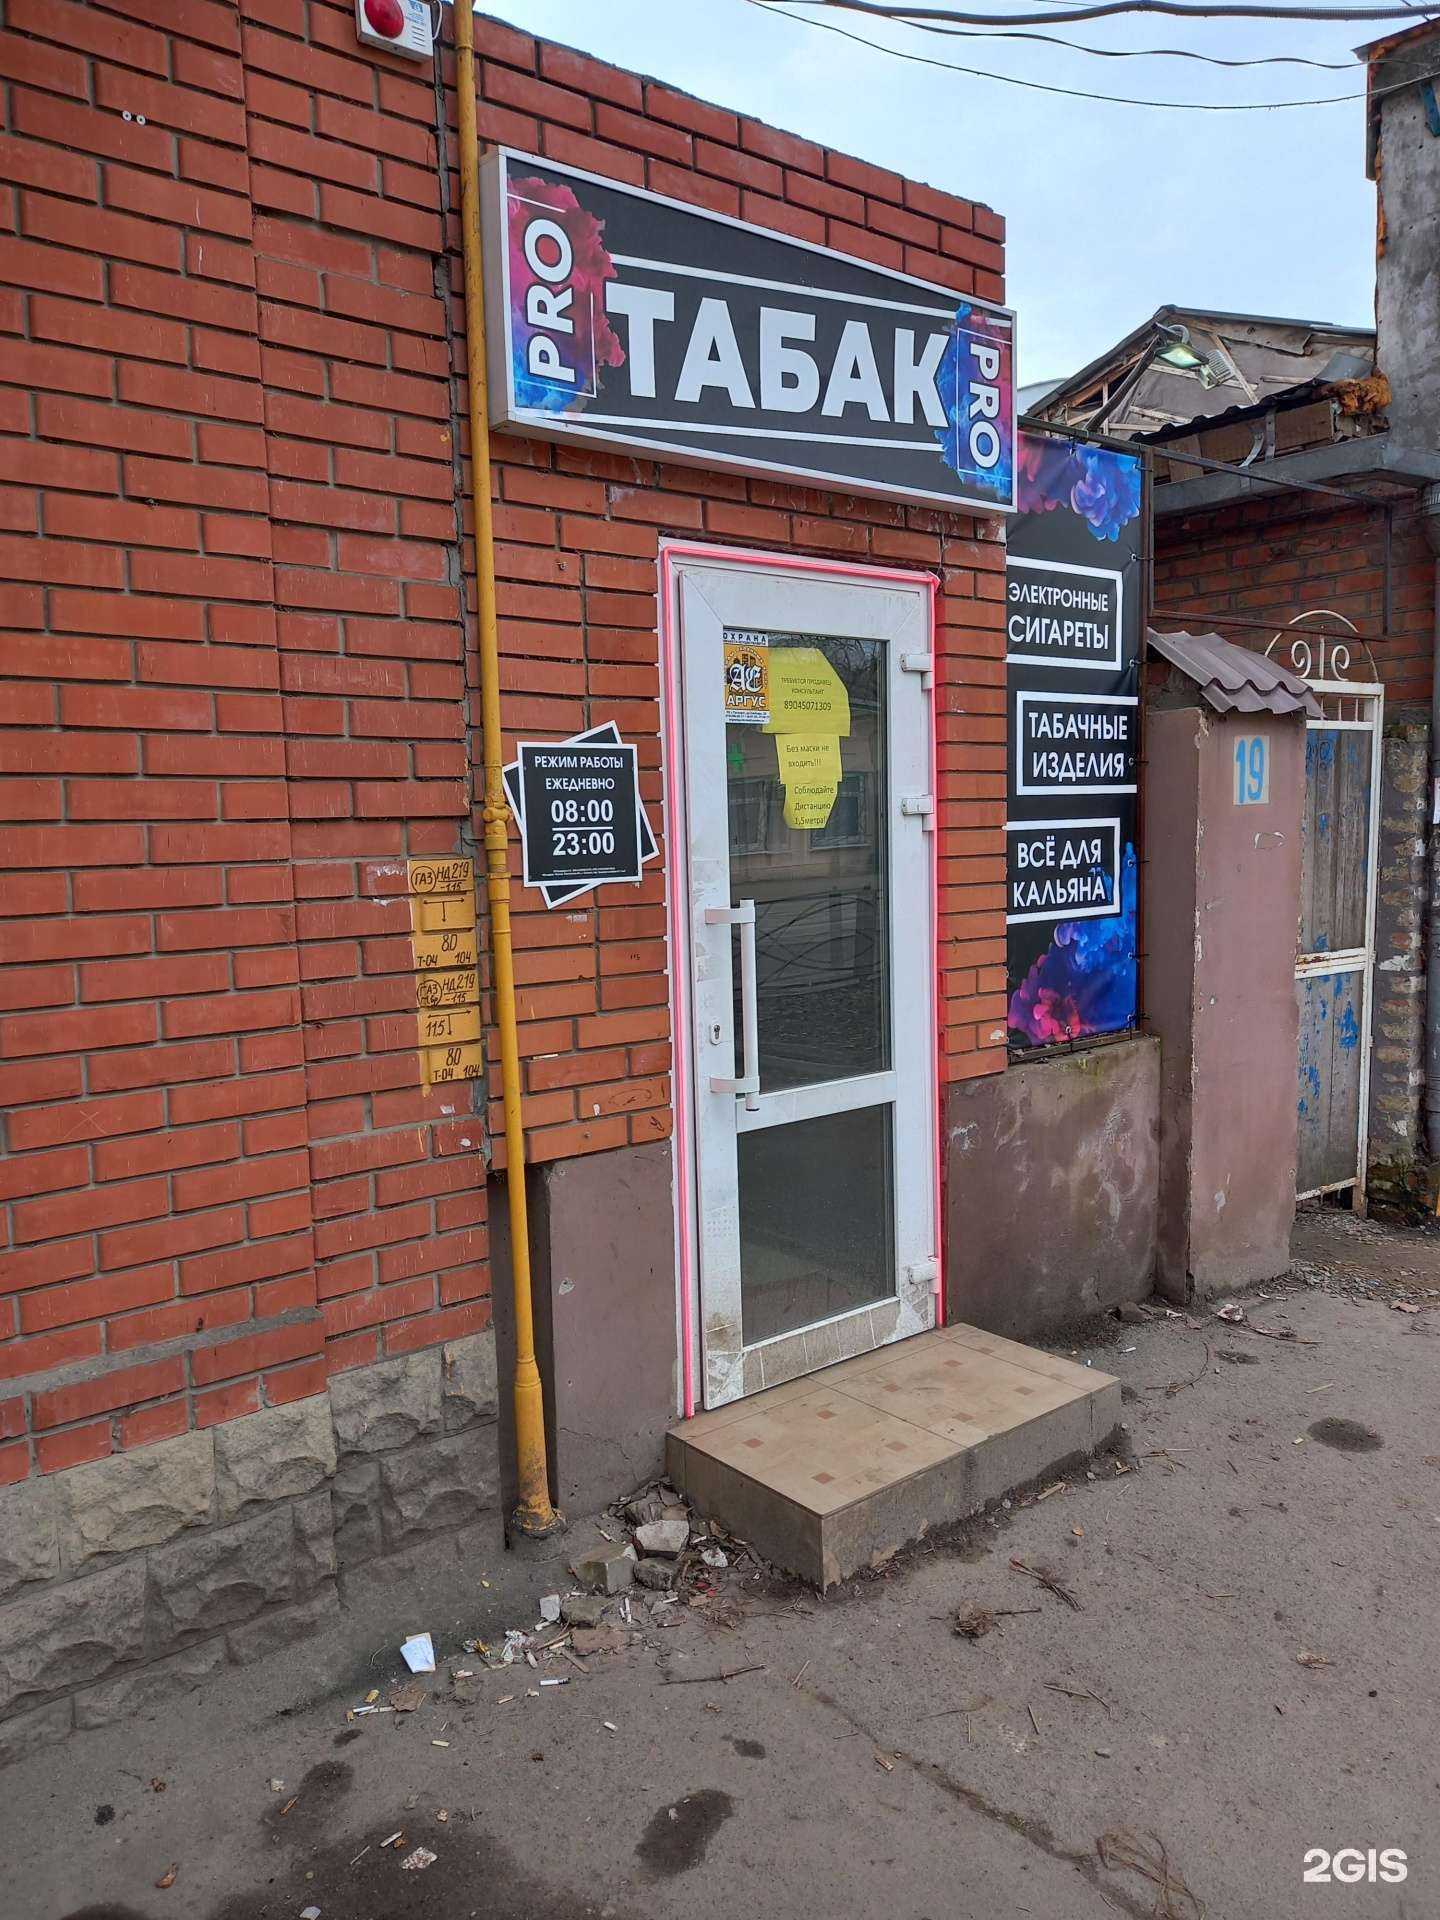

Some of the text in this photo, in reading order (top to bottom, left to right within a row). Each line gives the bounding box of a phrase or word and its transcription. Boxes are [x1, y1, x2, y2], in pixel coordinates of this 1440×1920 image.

[522, 216, 576, 384] PRO
[605, 281, 954, 428] ТАБАК
[968, 342, 1001, 470] PRO
[1008, 582, 1109, 612] ЭЛЕКТРОННЫЕ
[722, 632, 766, 643] ОХРАНА
[1008, 614, 1109, 650] СИГАРЕТЫ
[726, 694, 767, 708] АРГУС
[1028, 712, 1128, 741] ТАБАЧНЫЕ
[534, 756, 624, 769] РЕЖИМ РАБОТЫ
[786, 744, 830, 753] Без маски не
[1032, 752, 1125, 782] ИЗДЕЛИЯ
[1235, 736, 1265, 804] 19
[545, 778, 615, 792] ЕЖЕДНЕВНО
[551, 799, 614, 823] 08:00
[552, 831, 615, 856] 23:00
[1017, 836, 1102, 871] ВСЁ ДЛЯ
[414, 871, 433, 886] ГАЗ
[1013, 876, 1106, 908] КАЛЬЯНА
[420, 984, 438, 996] ГАЗ
